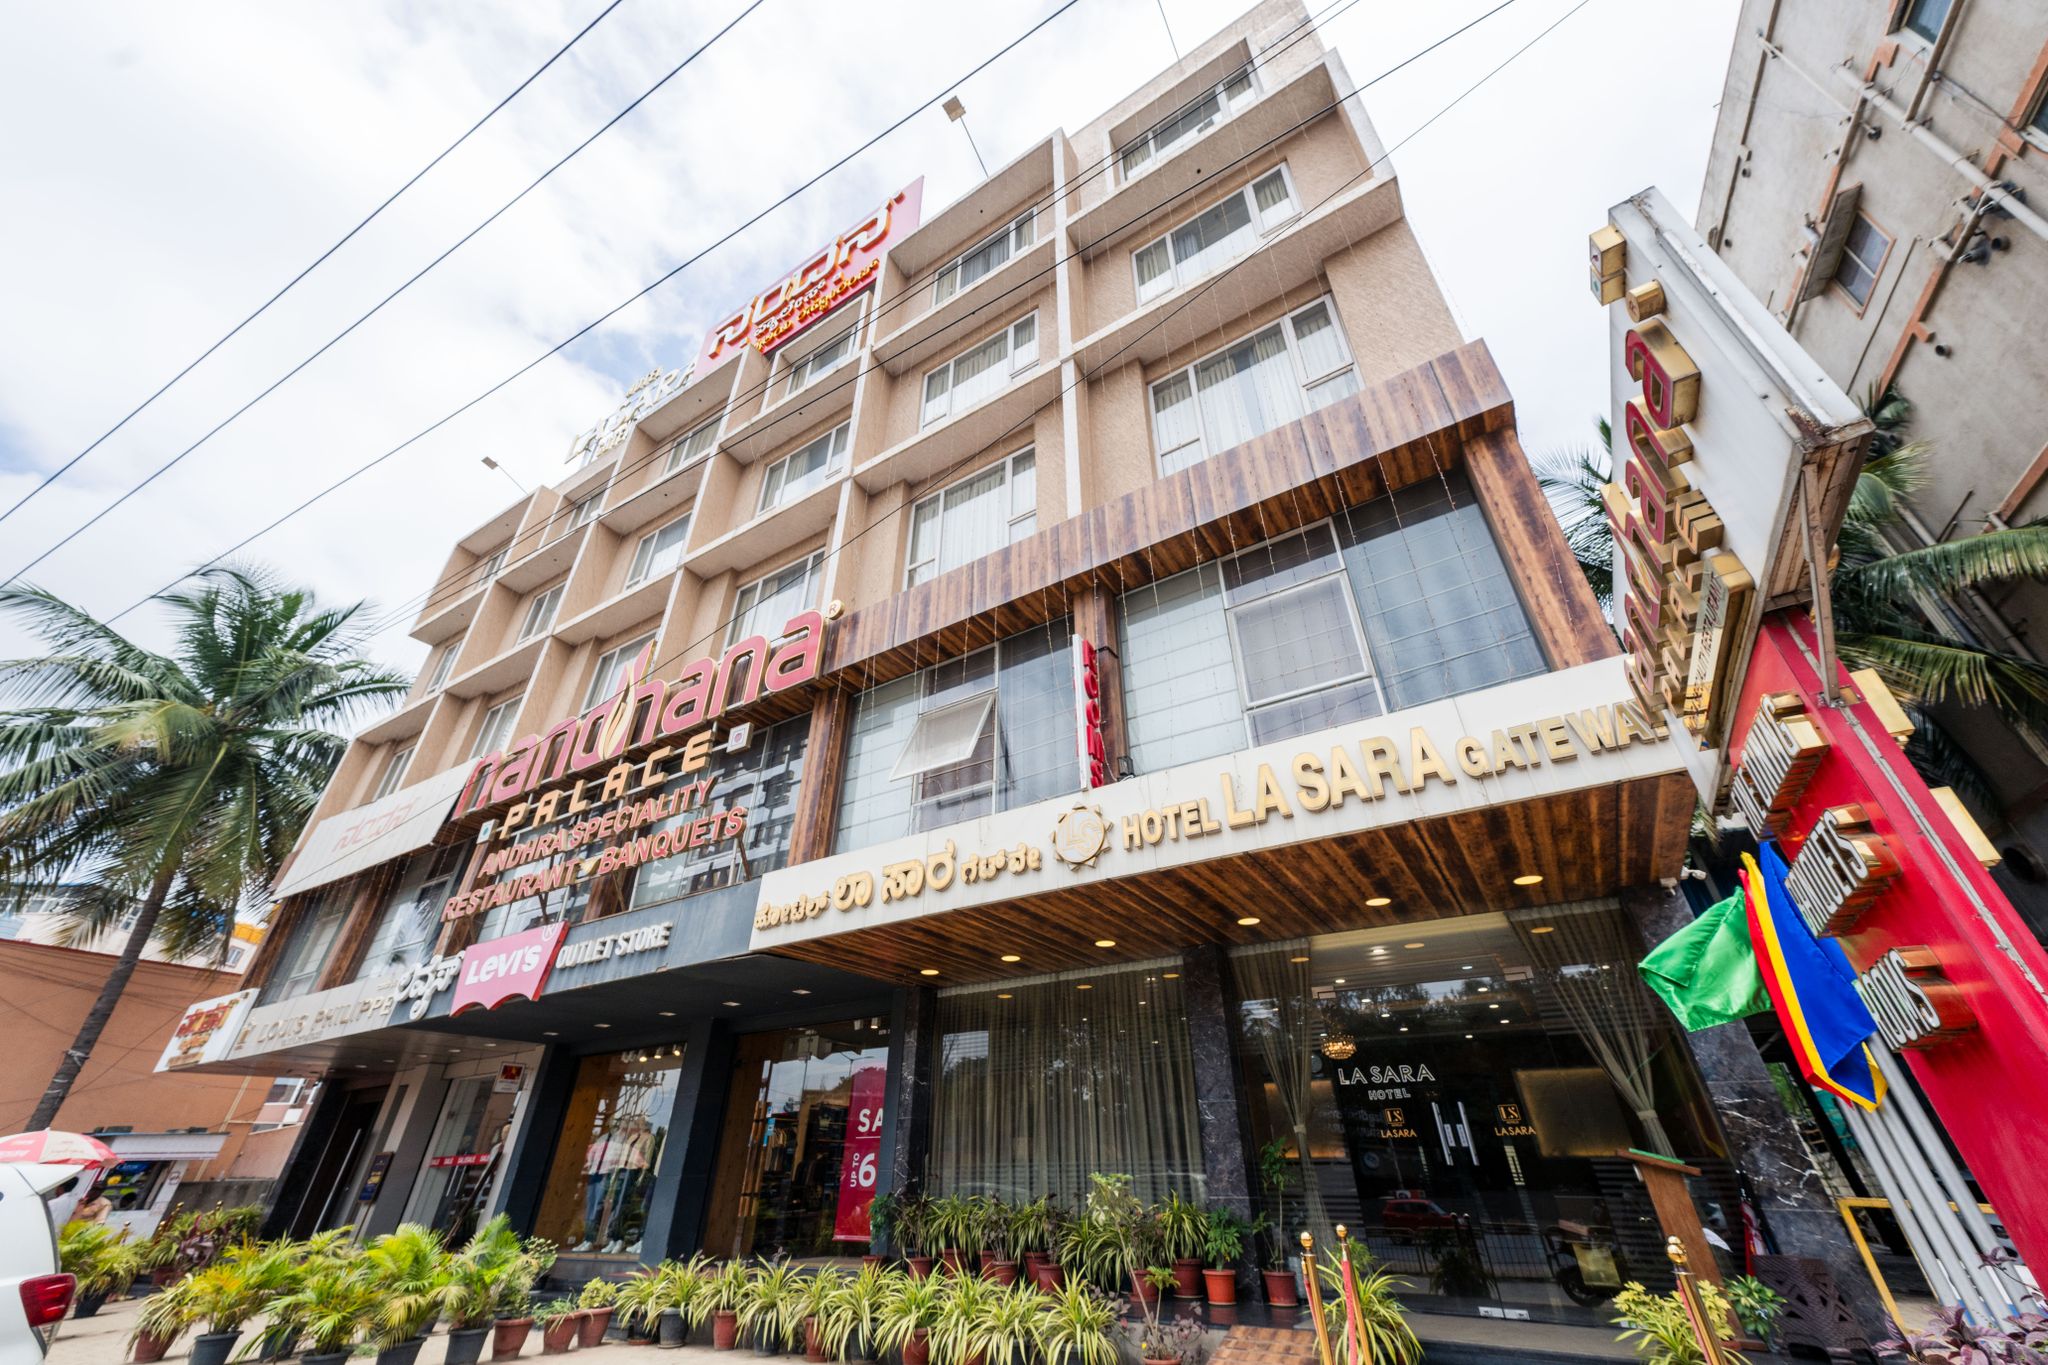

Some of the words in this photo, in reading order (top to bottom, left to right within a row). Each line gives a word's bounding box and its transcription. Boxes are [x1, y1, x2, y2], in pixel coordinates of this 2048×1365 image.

[451, 609, 826, 820] nandhana
[478, 828, 569, 879] ANDHRA
[568, 776, 717, 848] SPECIALITY
[499, 730, 715, 840] PALACE
[1121, 797, 1222, 851] HOTEL
[1220, 763, 1294, 830] LA
[1291, 726, 1458, 813] SARA
[440, 858, 580, 923] RESTAURANT
[600, 806, 749, 875] BANQUETS
[1784, 810, 1869, 940] BANQUETS
[556, 934, 617, 969] OUTLET
[614, 921, 674, 957] STORE
[1851, 947, 1941, 1052] ROOMS
[1367, 1088, 1412, 1101] HOTEL
